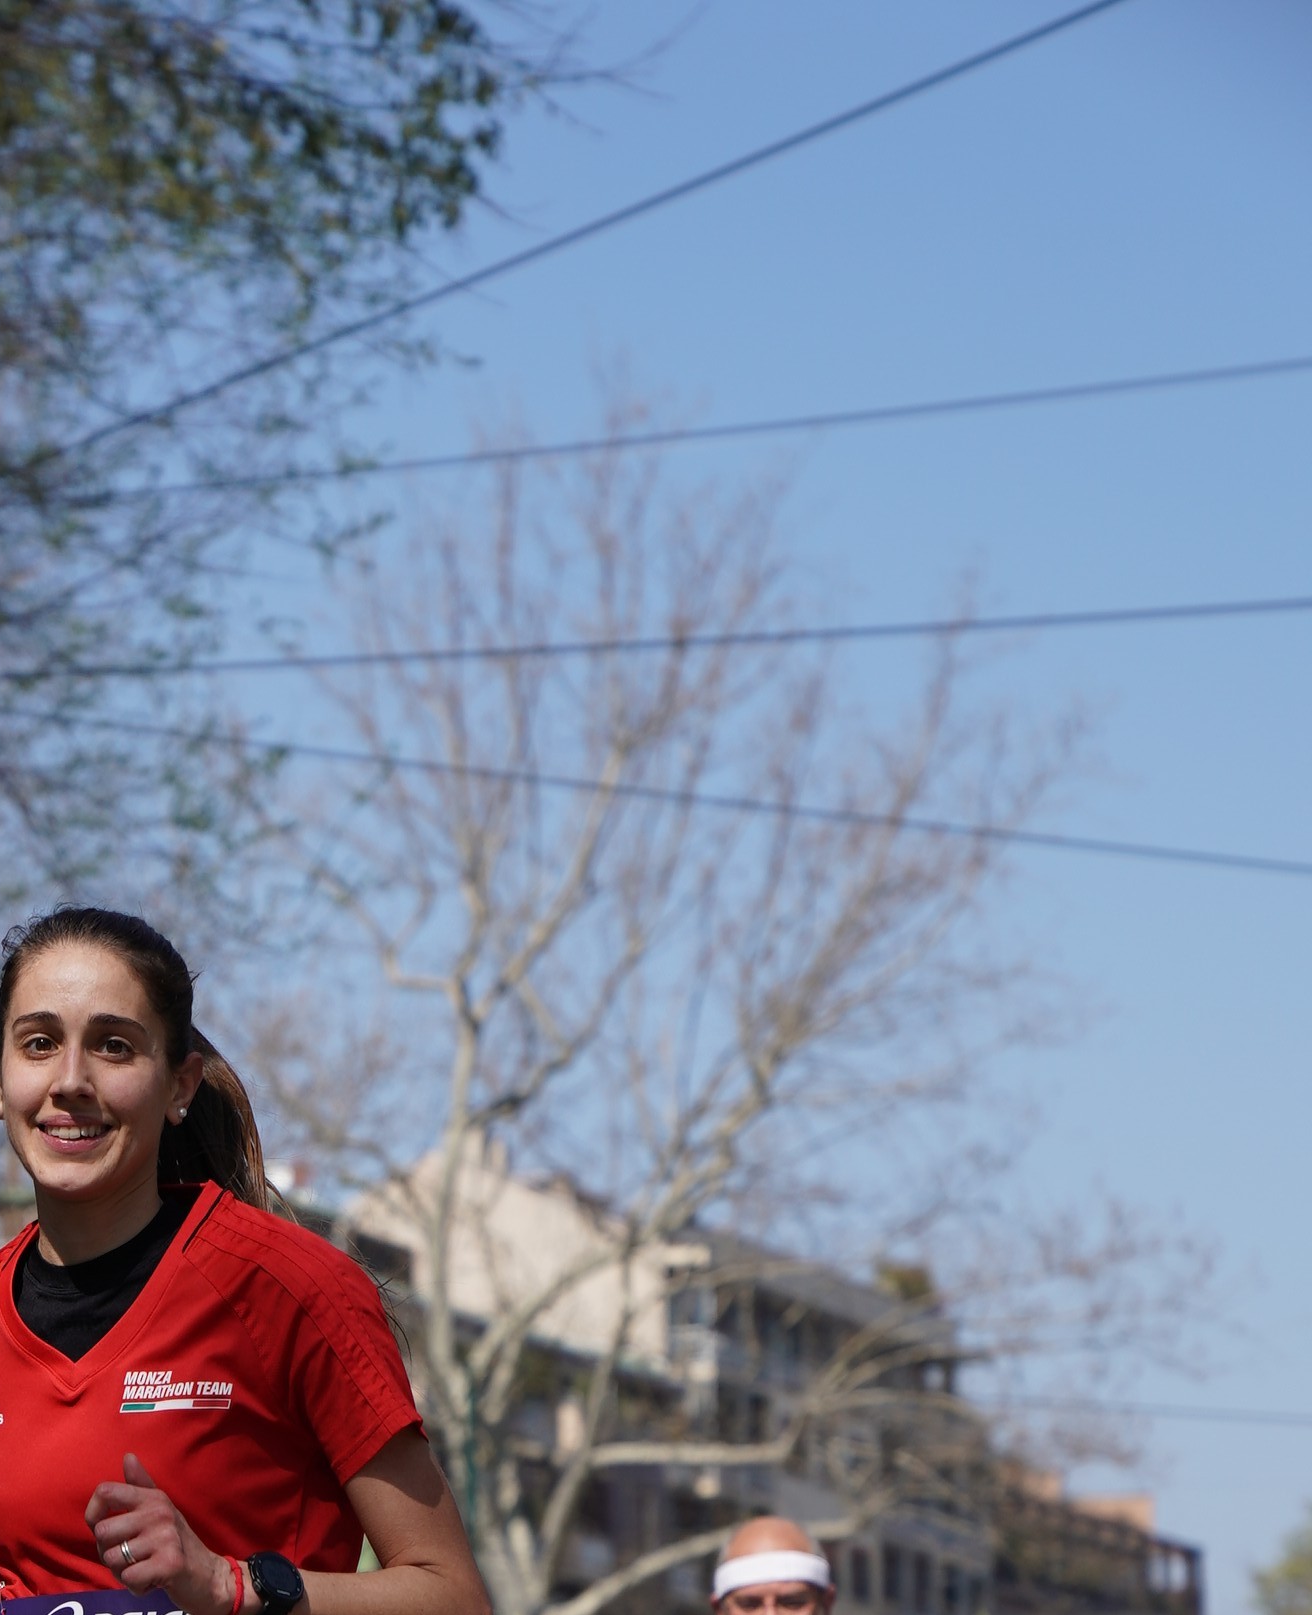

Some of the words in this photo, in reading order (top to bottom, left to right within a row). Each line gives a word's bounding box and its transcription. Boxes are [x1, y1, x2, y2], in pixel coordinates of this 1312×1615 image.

[123, 1370, 173, 1386] MONZA
[122, 1381, 194, 1400] MARATHON
[196, 1381, 234, 1396] TEAM
